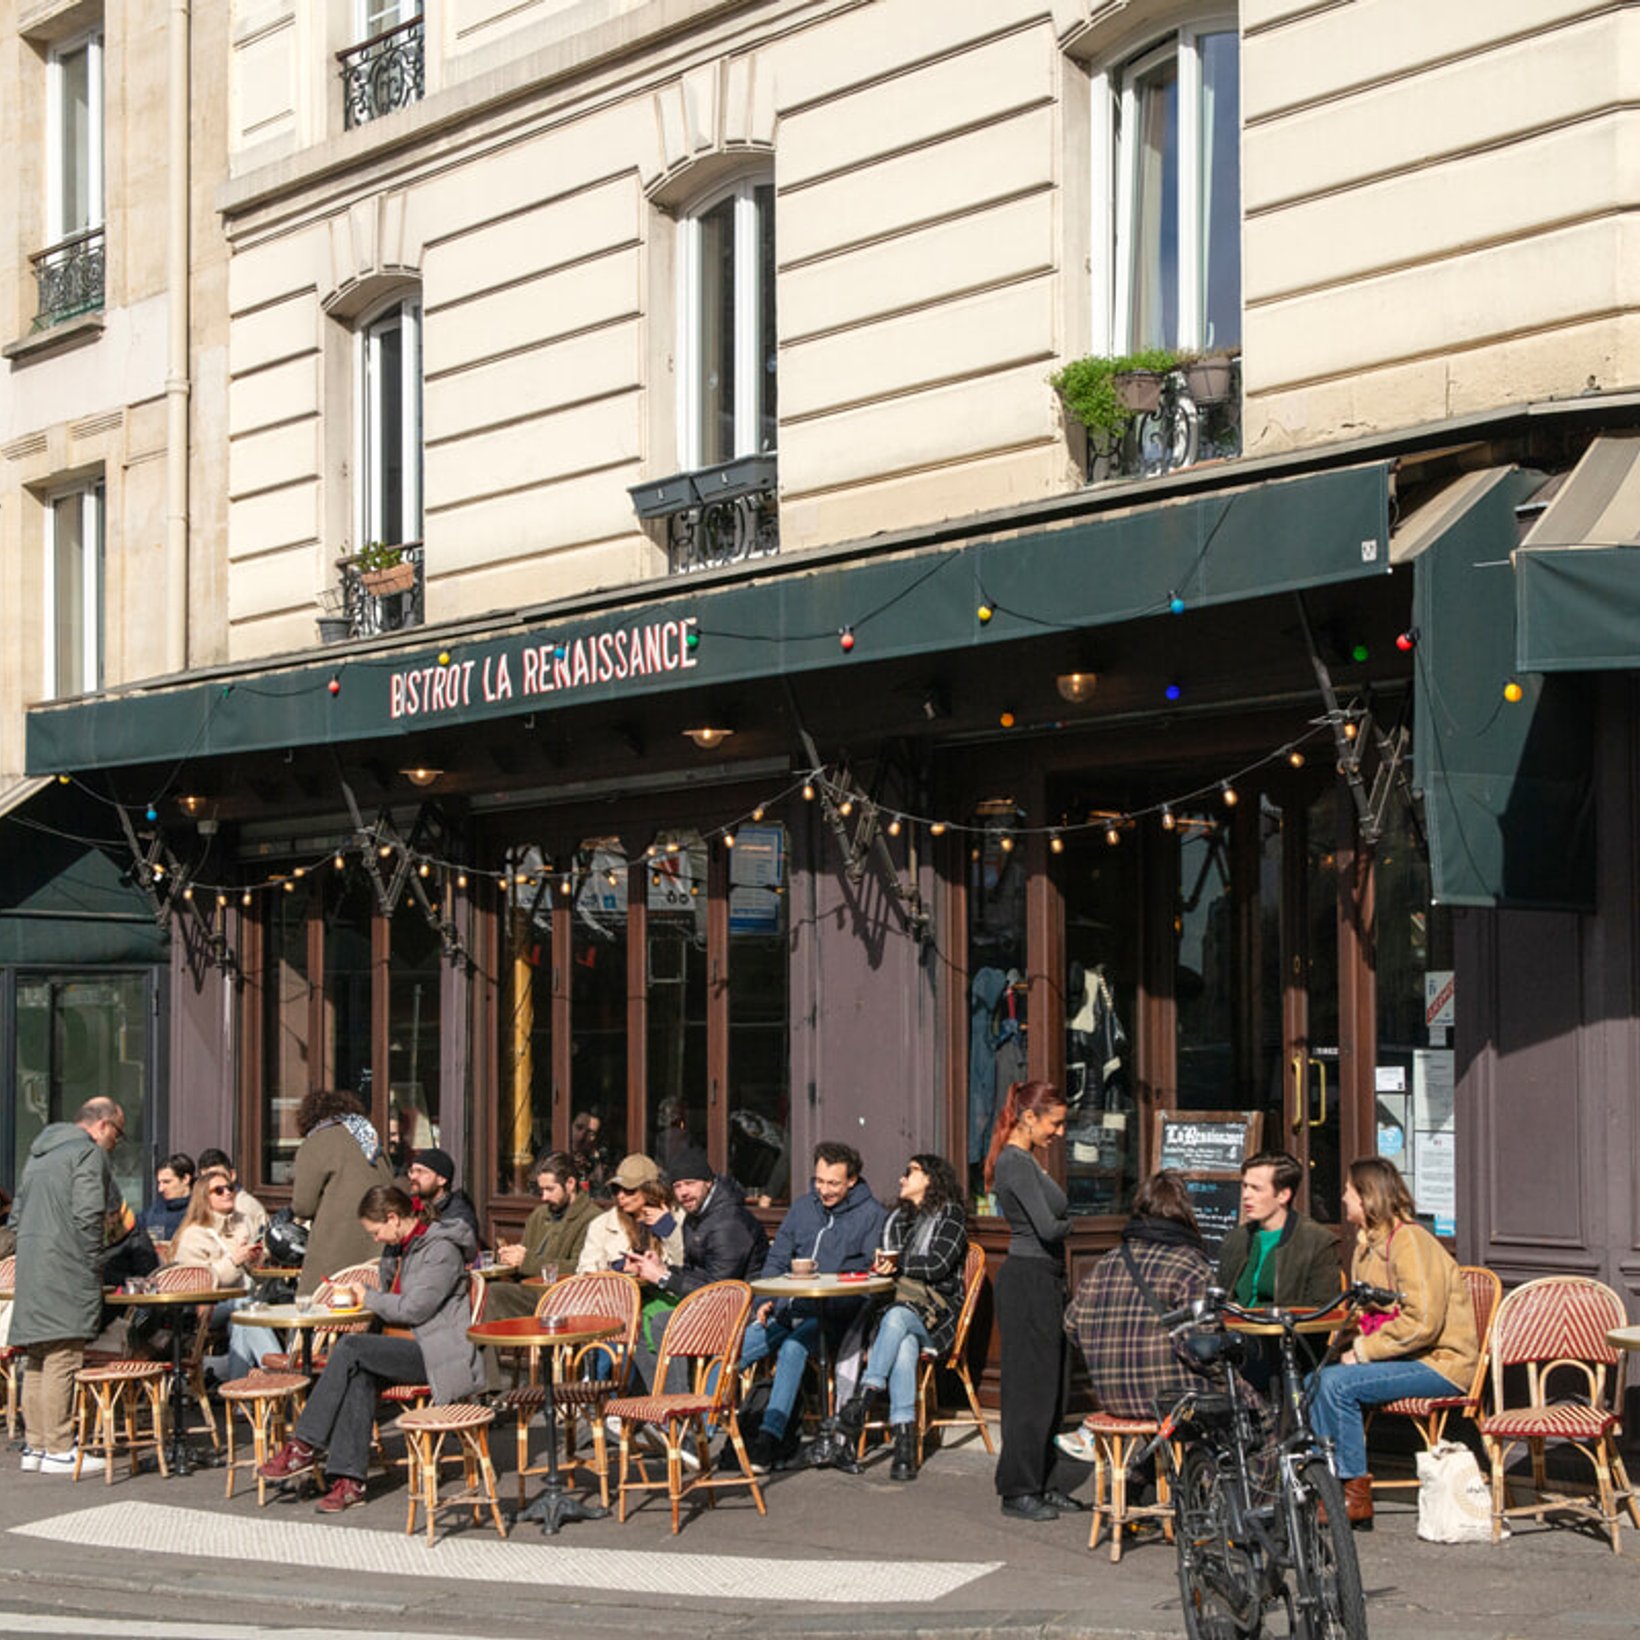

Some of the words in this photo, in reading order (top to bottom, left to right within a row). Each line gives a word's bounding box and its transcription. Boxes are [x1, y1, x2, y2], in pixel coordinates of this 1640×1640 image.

[390, 660, 476, 719] BISTROT
[482, 653, 513, 703] LA
[522, 616, 698, 696] RENAISSANCE
